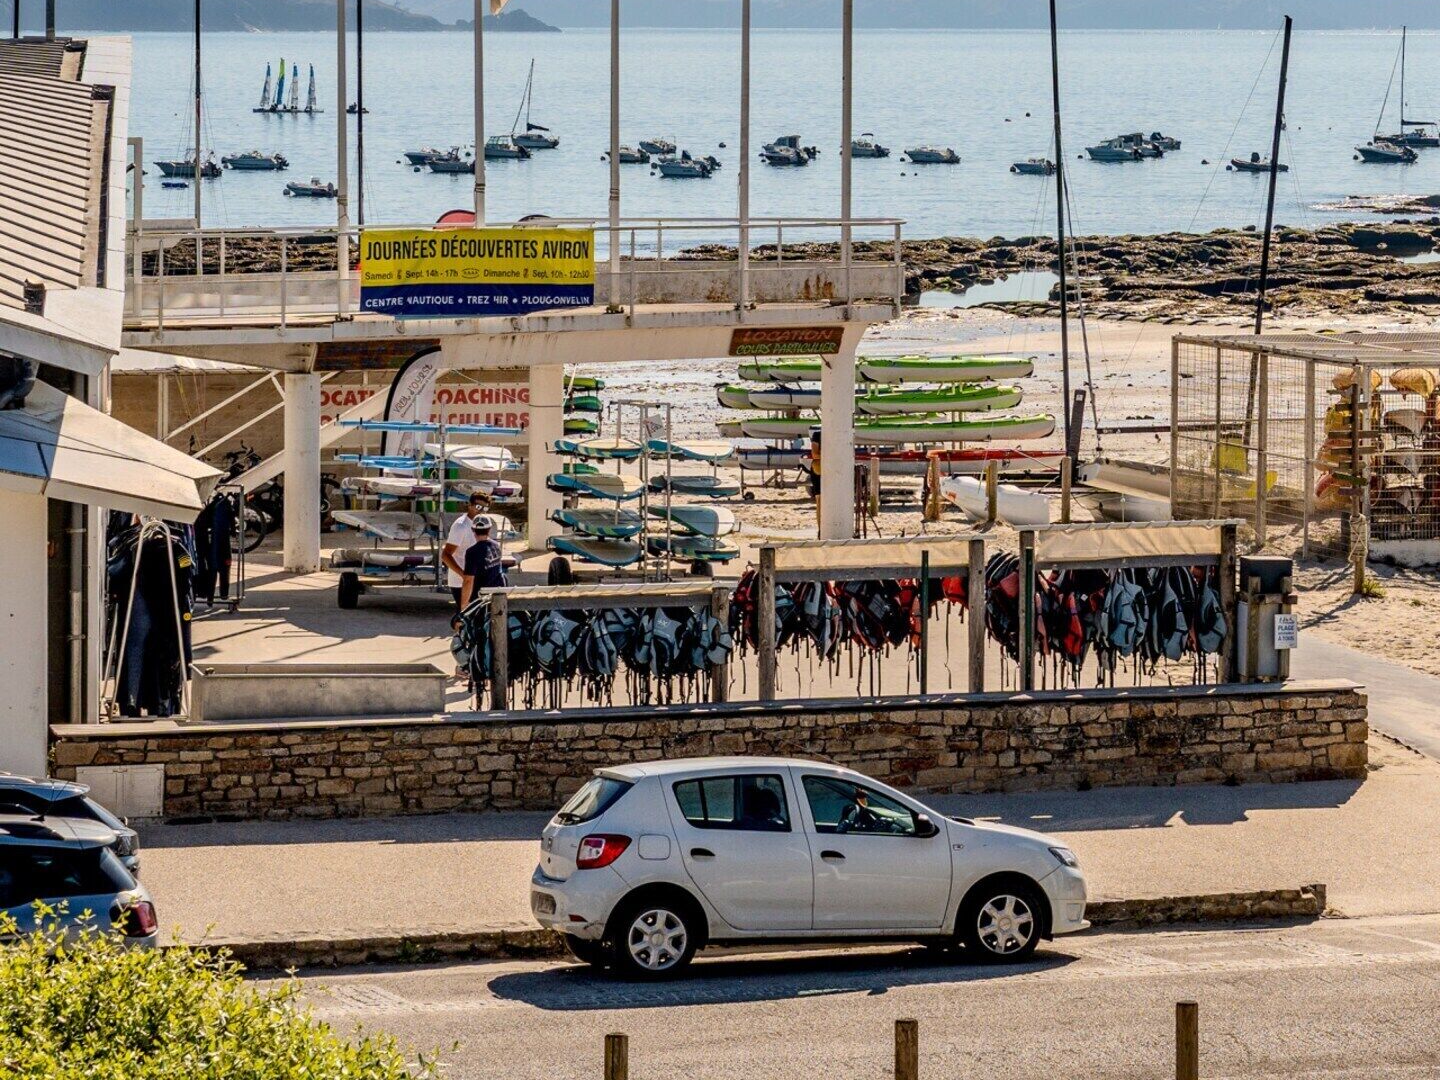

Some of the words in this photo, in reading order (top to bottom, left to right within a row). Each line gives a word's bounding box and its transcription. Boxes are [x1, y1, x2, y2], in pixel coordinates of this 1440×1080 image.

[366, 236, 436, 261] JOURNÉES
[441, 235, 538, 259] DÉCOUVERTES
[541, 240, 589, 259] AVIRON
[365, 271, 393, 281] Samedi
[445, 268, 459, 277] 17h
[483, 268, 520, 278] Dimanche
[365, 296, 404, 308] CENTRE
[467, 295, 489, 305] TREZ
[522, 295, 590, 305] PLOUGONVELIN
